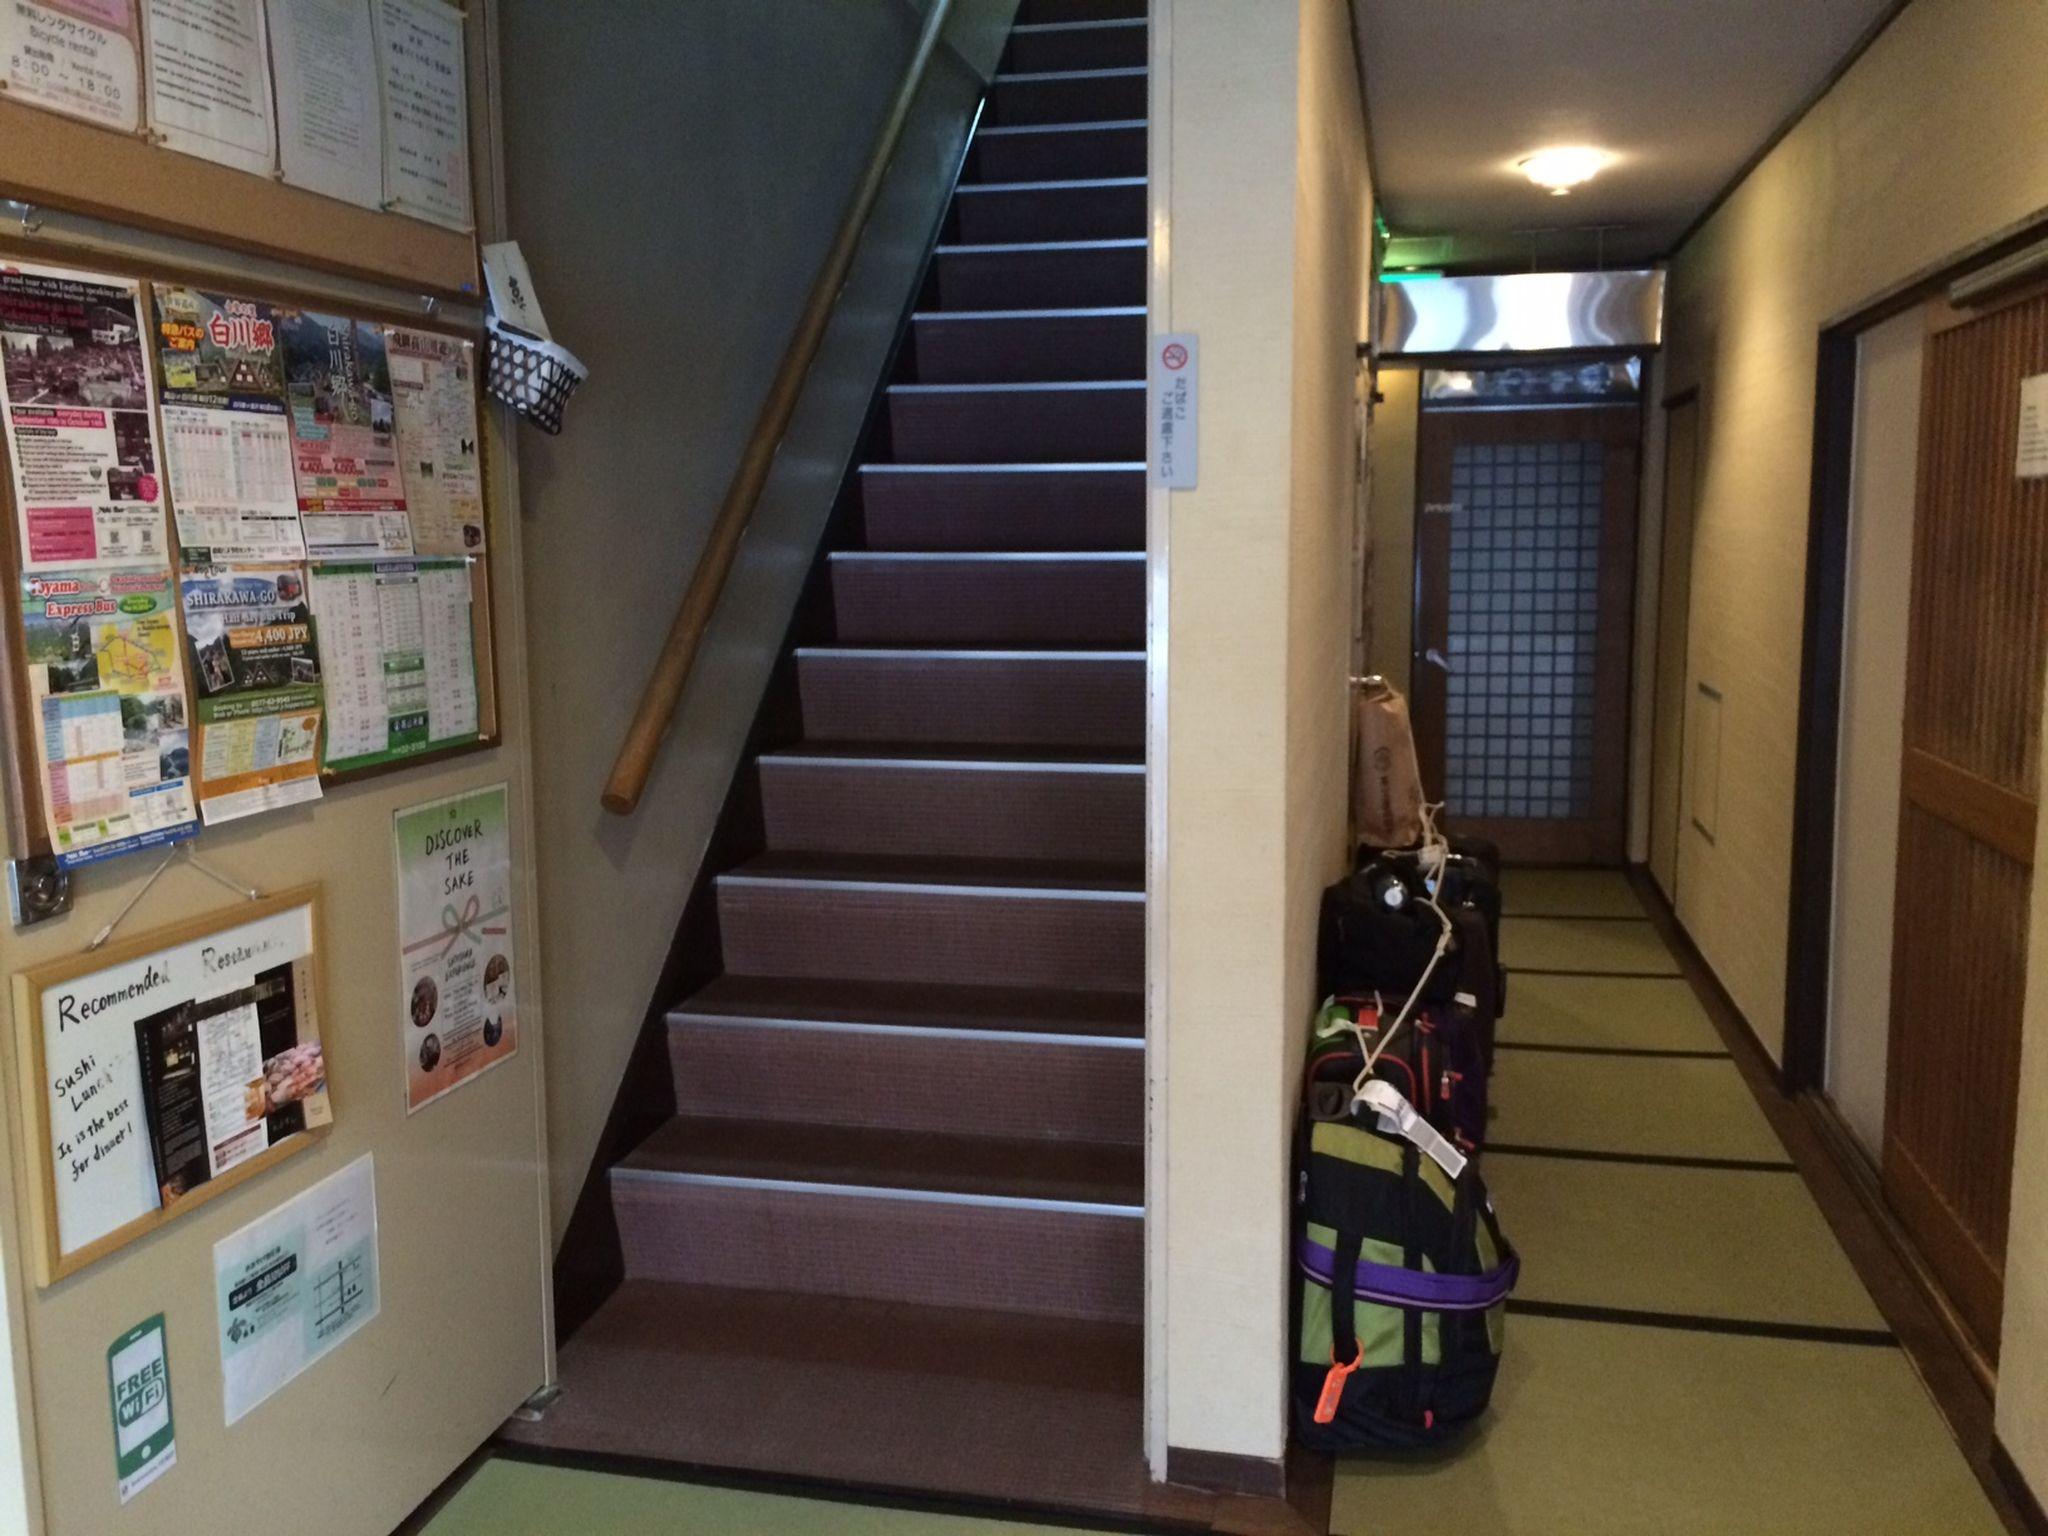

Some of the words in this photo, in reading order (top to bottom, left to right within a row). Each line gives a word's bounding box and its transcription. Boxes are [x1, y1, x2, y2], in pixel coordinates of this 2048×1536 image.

[207, 311, 275, 356] 白川郷
[46, 601, 94, 619] Express
[95, 598, 117, 615] Bus
[255, 627, 286, 645] 4,400
[288, 626, 309, 642] JPY
[425, 819, 483, 856] DISCOVER
[444, 848, 470, 871] THE
[444, 870, 474, 896] SAKE
[58, 961, 172, 1033] Recommended
[55, 1055, 96, 1098] Sushi
[57, 1142, 73, 1161] It
[75, 1130, 87, 1145] is
[87, 1118, 105, 1137] the
[106, 1098, 129, 1122] best
[71, 1156, 90, 1183] for
[116, 1356, 163, 1403] FREE
